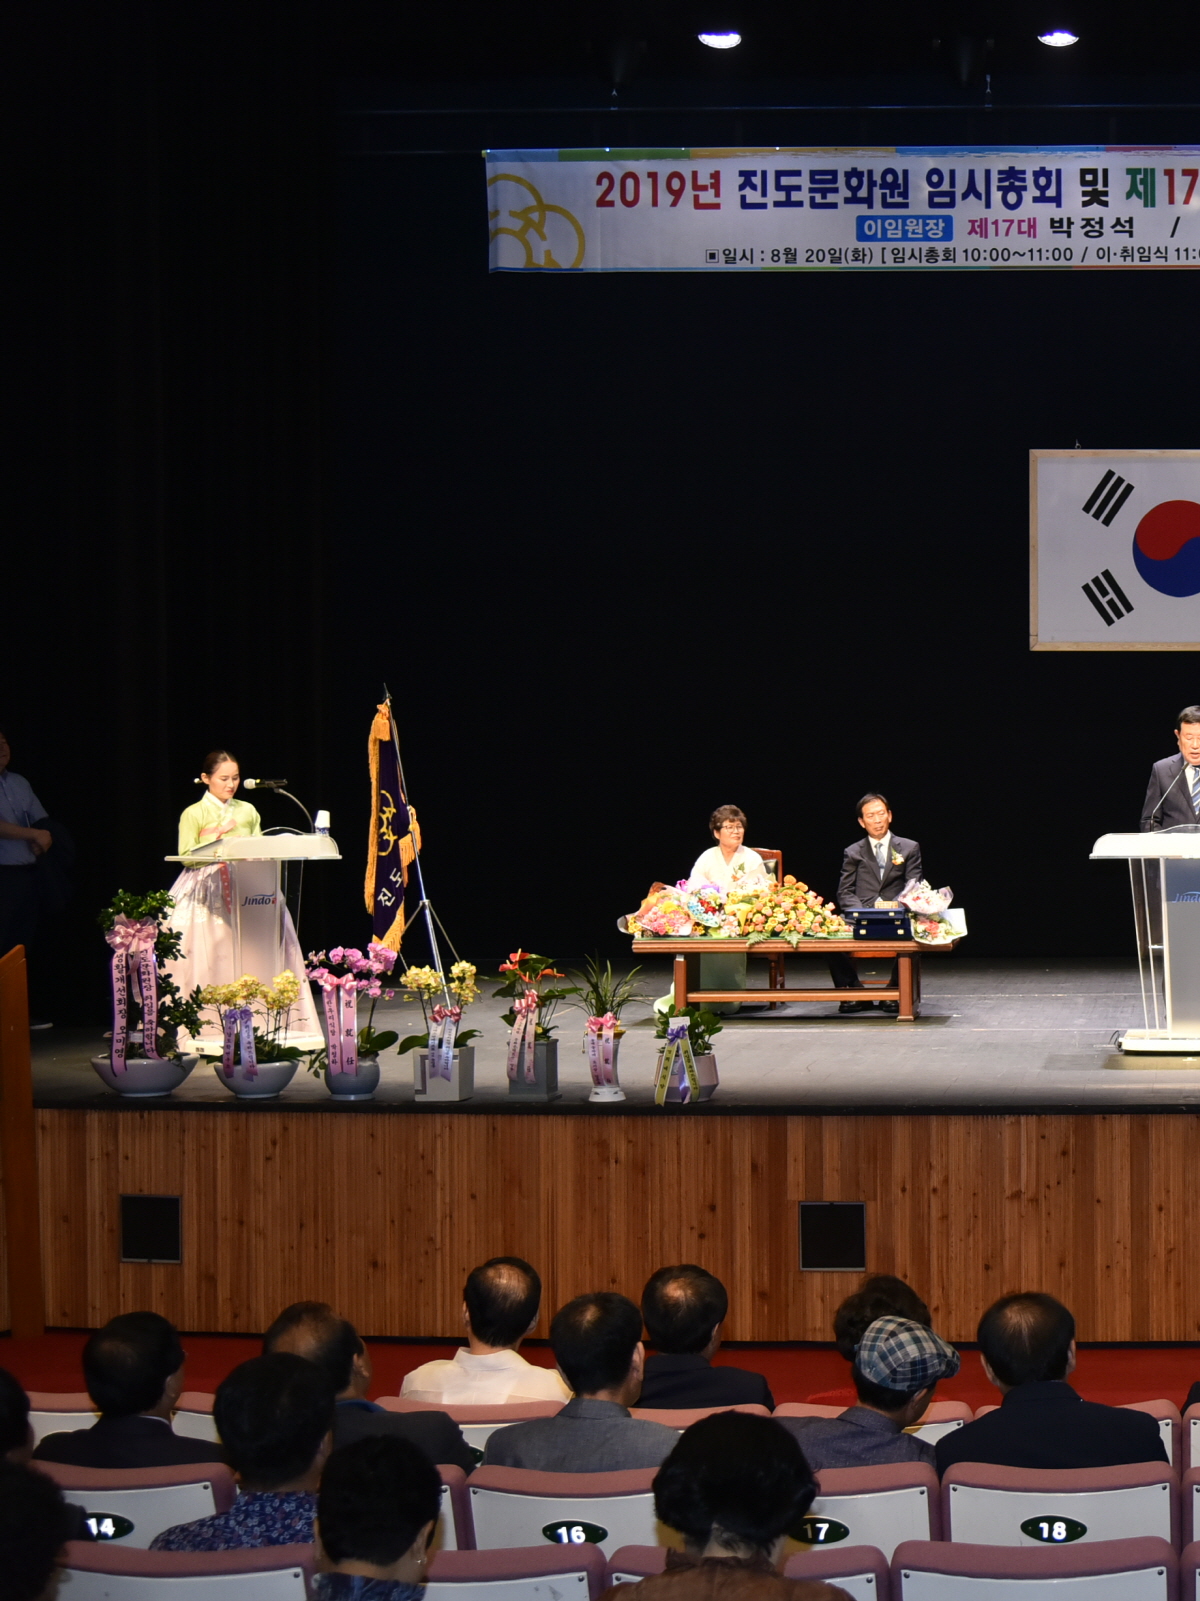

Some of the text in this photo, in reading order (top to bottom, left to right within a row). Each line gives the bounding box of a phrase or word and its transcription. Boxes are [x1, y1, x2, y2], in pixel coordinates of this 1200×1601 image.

[596, 170, 721, 210] 2019년
[738, 167, 909, 210] 진도문화원
[926, 166, 1063, 211] 임시총회
[1080, 167, 1109, 209] 및
[863, 218, 945, 239] 이임원장
[967, 217, 1037, 239] 제17대
[1050, 216, 1134, 239] 박정석
[770, 248, 798, 264] 8월
[805, 247, 873, 265] 20일(화)
[962, 247, 1074, 263] 10:00~11:00
[87, 1517, 116, 1538] 14
[556, 1526, 586, 1544] 16
[805, 1522, 830, 1541] 17
[1039, 1521, 1067, 1541] 18
